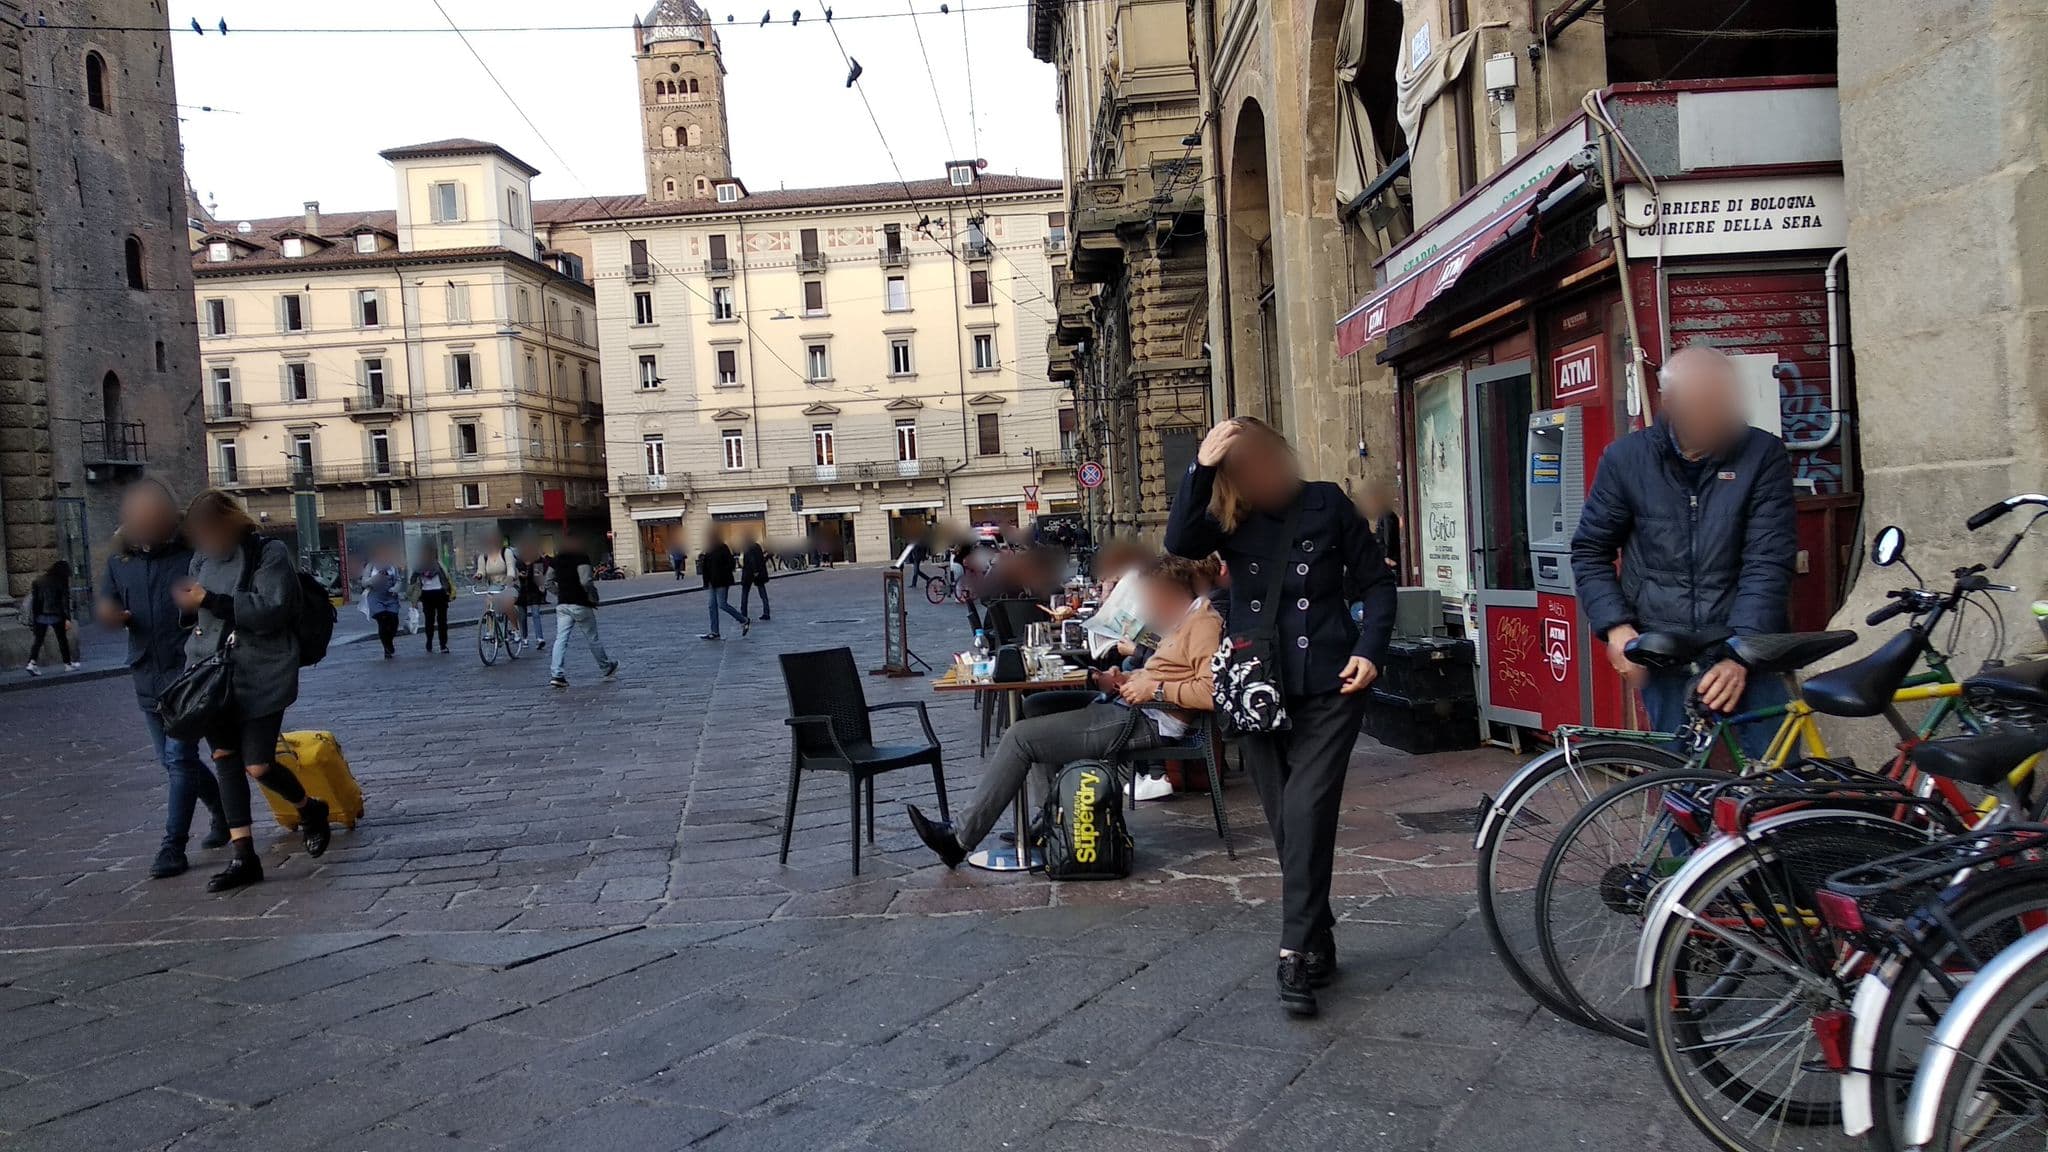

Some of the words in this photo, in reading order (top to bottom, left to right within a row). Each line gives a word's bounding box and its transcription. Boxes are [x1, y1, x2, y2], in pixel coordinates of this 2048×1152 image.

[1726, 199, 1744, 213] DI
[1750, 195, 1816, 211] BOLOGNA
[1723, 218, 1773, 233] DELLA
[1782, 215, 1822, 230] SERA
[1560, 356, 1591, 389] ATM
[1549, 626, 1566, 641] ATM
